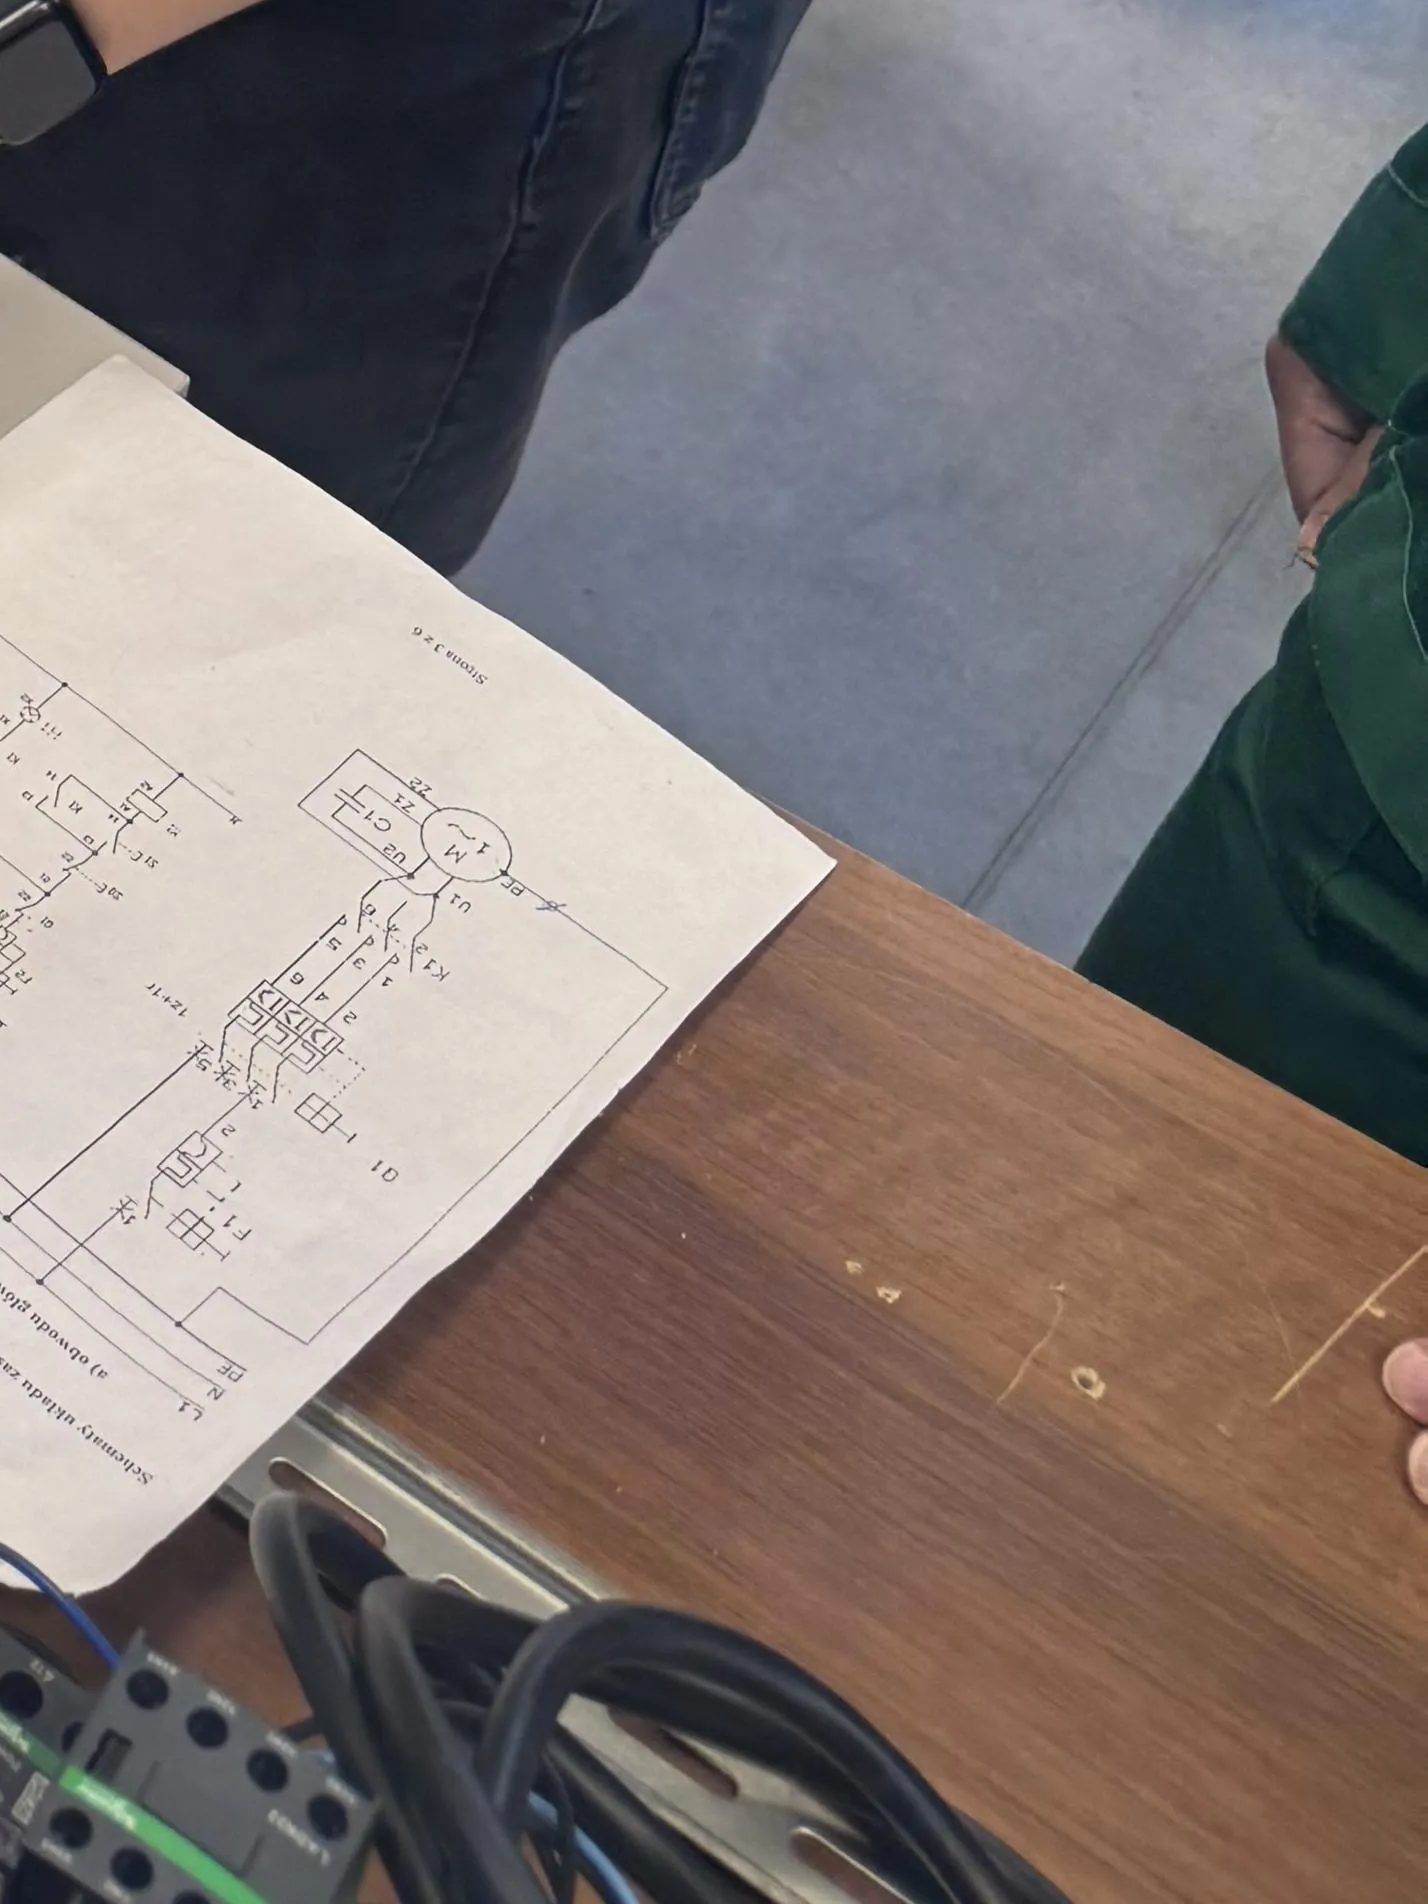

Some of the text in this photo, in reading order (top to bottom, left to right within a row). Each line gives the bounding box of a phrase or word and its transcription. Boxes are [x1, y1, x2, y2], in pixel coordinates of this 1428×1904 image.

[446, 651, 487, 684] Strona
[364, 810, 391, 831] C1
[450, 893, 471, 913] U1
[423, 959, 449, 981] K1
[223, 1215, 252, 1240] F1
[30, 1313, 88, 1364] obwodu
[90, 1364, 108, 1378] a)
[77, 1425, 152, 1484] Schematy
